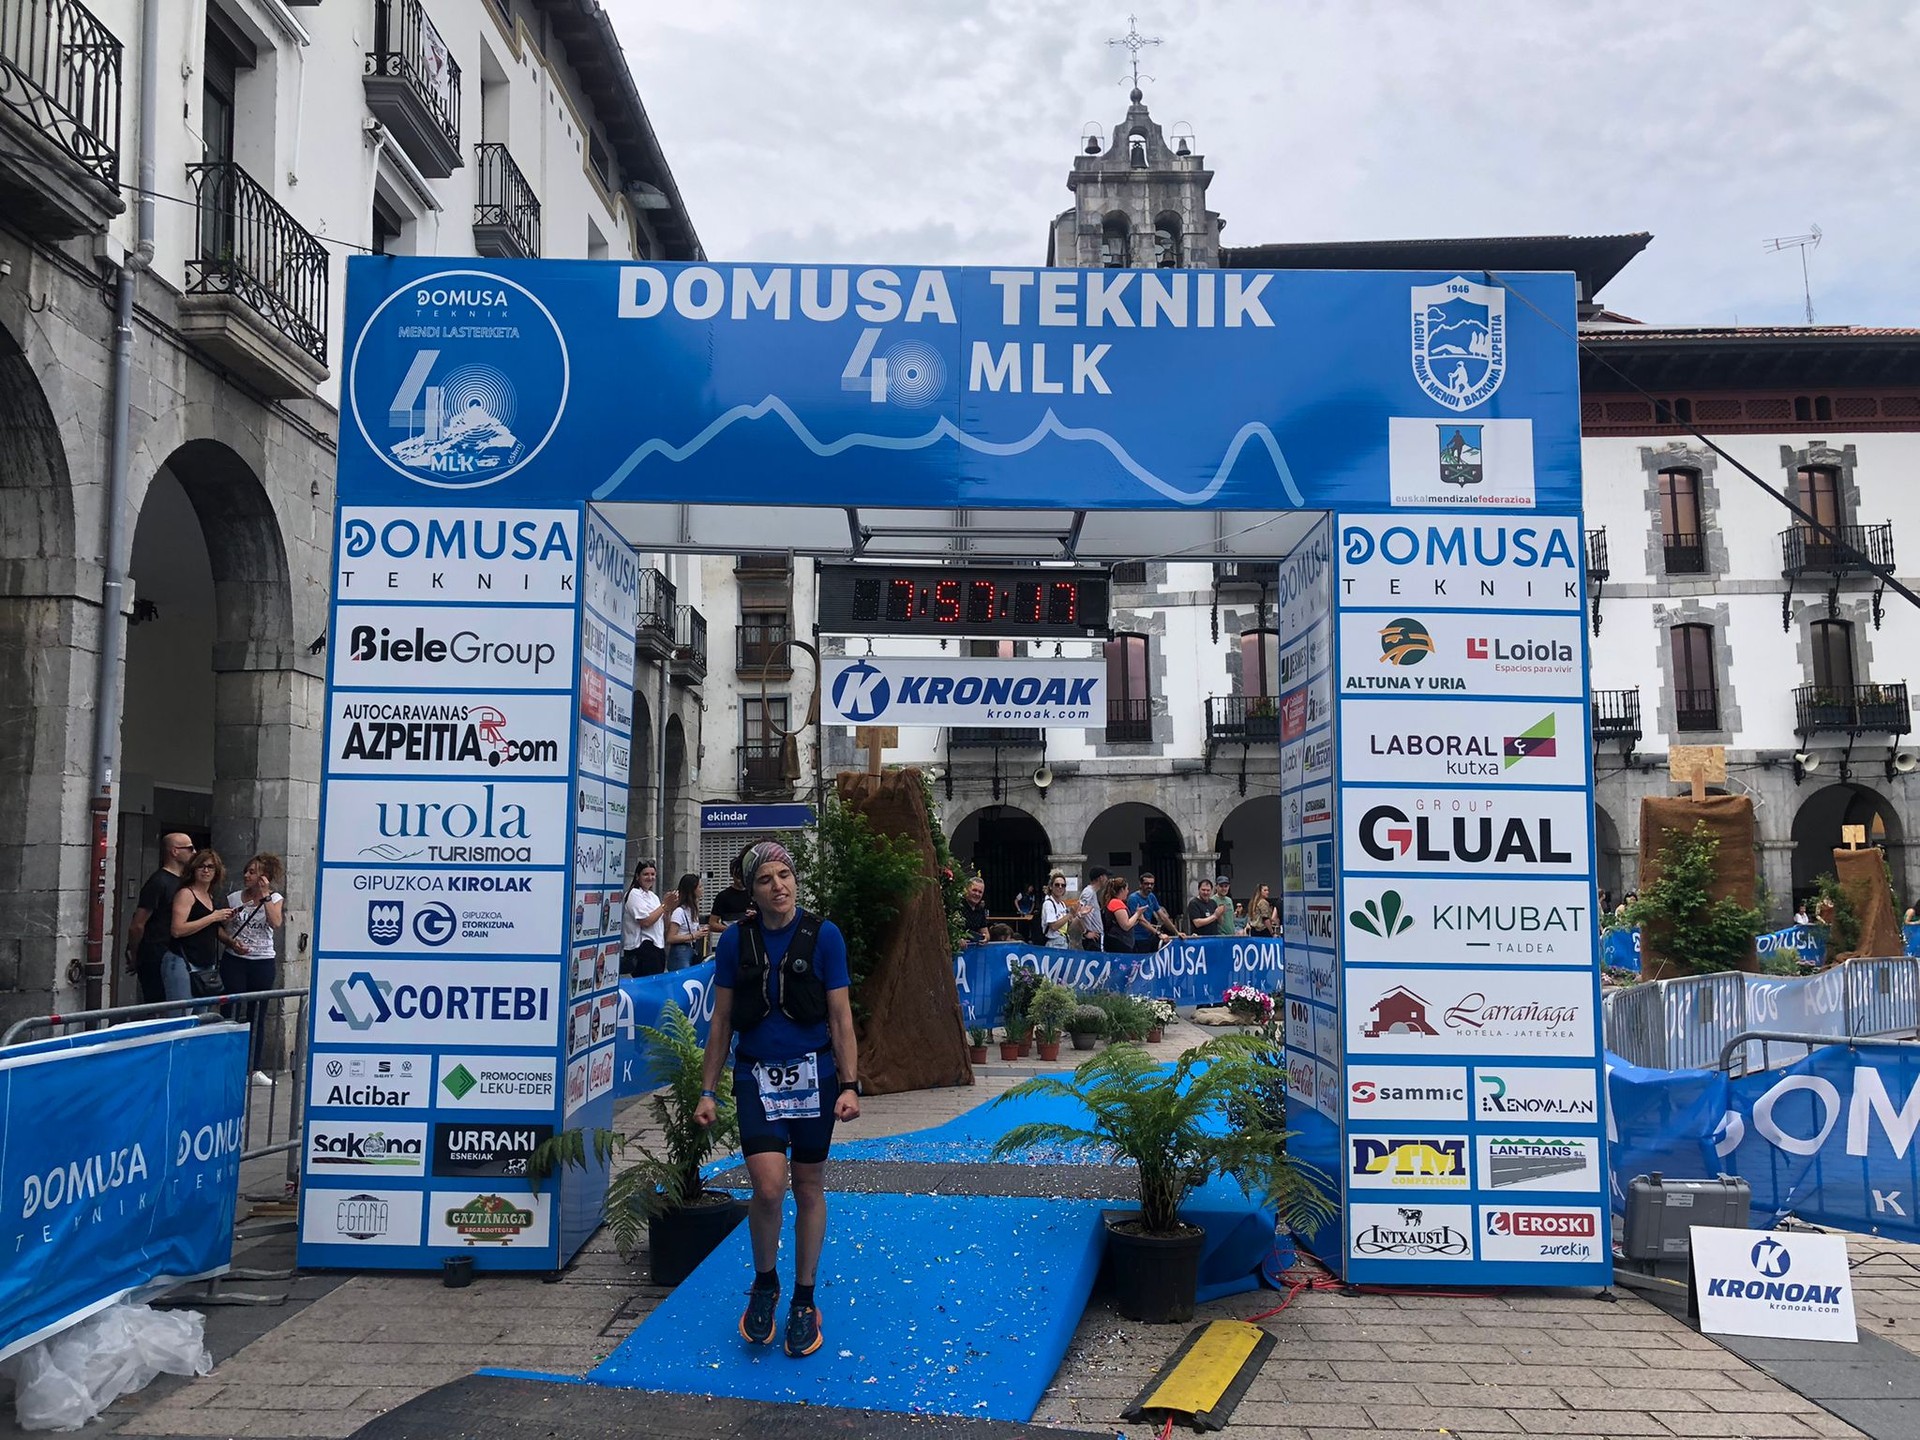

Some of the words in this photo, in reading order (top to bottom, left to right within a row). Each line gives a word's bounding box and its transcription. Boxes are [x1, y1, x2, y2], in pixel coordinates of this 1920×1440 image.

[417, 289, 508, 307] DOMUSA
[617, 266, 957, 324] DOMUSA
[989, 270, 1276, 328] TEKNIK
[1446, 285, 1469, 293] 1946
[416, 310, 508, 318] TEKNIK
[398, 326, 440, 338] MENDI
[443, 326, 520, 339] LASTERKETA
[1413, 313, 1425, 351] LAGUN
[1491, 314, 1503, 366] AZPEITIA
[969, 341, 1113, 395] MLK
[1414, 354, 1431, 385] ONAK
[1427, 382, 1460, 408] MENDI
[1463, 368, 1501, 407] BAZKUNA
[430, 454, 474, 472] MLK
[1396, 494, 1531, 505] euskalmendizalefederazioa
[344, 519, 573, 561] DOMUSA
[1343, 526, 1575, 568] DOMUSA
[588, 523, 636, 600] DOMUSA
[341, 571, 573, 591] TEKNIK
[1342, 579, 1577, 598] TEKNIK
[894, 579, 1077, 623] 7:57:17
[1495, 638, 1573, 662] Loiola
[1495, 663, 1532, 673] Espacios
[1534, 666, 1553, 674] para
[1555, 665, 1573, 673] vivir
[896, 676, 1099, 706] KRONOAK
[1346, 676, 1410, 689] ALTUNA
[1414, 677, 1425, 689] Y
[1429, 677, 1466, 690] URIA
[342, 704, 469, 721] AUTOCARAVANAS
[987, 708, 1090, 719] kronoak.com
[1371, 735, 1498, 757] LABORAL
[1447, 760, 1499, 776] kutxa
[375, 784, 532, 839] urola
[1416, 799, 1493, 812] GROUP
[706, 811, 748, 821] ekindar
[1358, 805, 1572, 863] GLUAL
[353, 875, 444, 892] GIPUZKOA
[447, 876, 533, 892] KIROLAK
[462, 911, 502, 920] GIPUZKOA
[1433, 905, 1586, 932] KIMUBAT
[461, 930, 489, 938] ORAIN
[462, 921, 515, 930] ETORKIZUNA
[1497, 943, 1555, 953] TALDEA
[394, 985, 549, 1021] CORTEBI
[1443, 992, 1579, 1030] Larrañaga
[1514, 1030, 1575, 1038] JATETXEA
[480, 1071, 553, 1082] PROMOCIONES
[767, 1065, 800, 1087] 95
[327, 1085, 410, 1106] Alcibar
[480, 1083, 552, 1096] LEKU-EDER
[1380, 1086, 1463, 1101] sammic
[448, 1130, 536, 1151] URRAKI
[450, 1152, 494, 1161] ESNEKIAK
[1353, 1139, 1466, 1176] DTM
[1490, 1146, 1571, 1156] LAN-TRANS
[22, 1142, 148, 1219] DOMUSA
[1371, 1225, 1450, 1244] INTXAUSTI
[1518, 1217, 1589, 1233] EROSKI
[1540, 1242, 1590, 1261] zurekin
[1707, 1278, 1843, 1305] KRONOAK
[1769, 1302, 1840, 1314] kronoak.com
